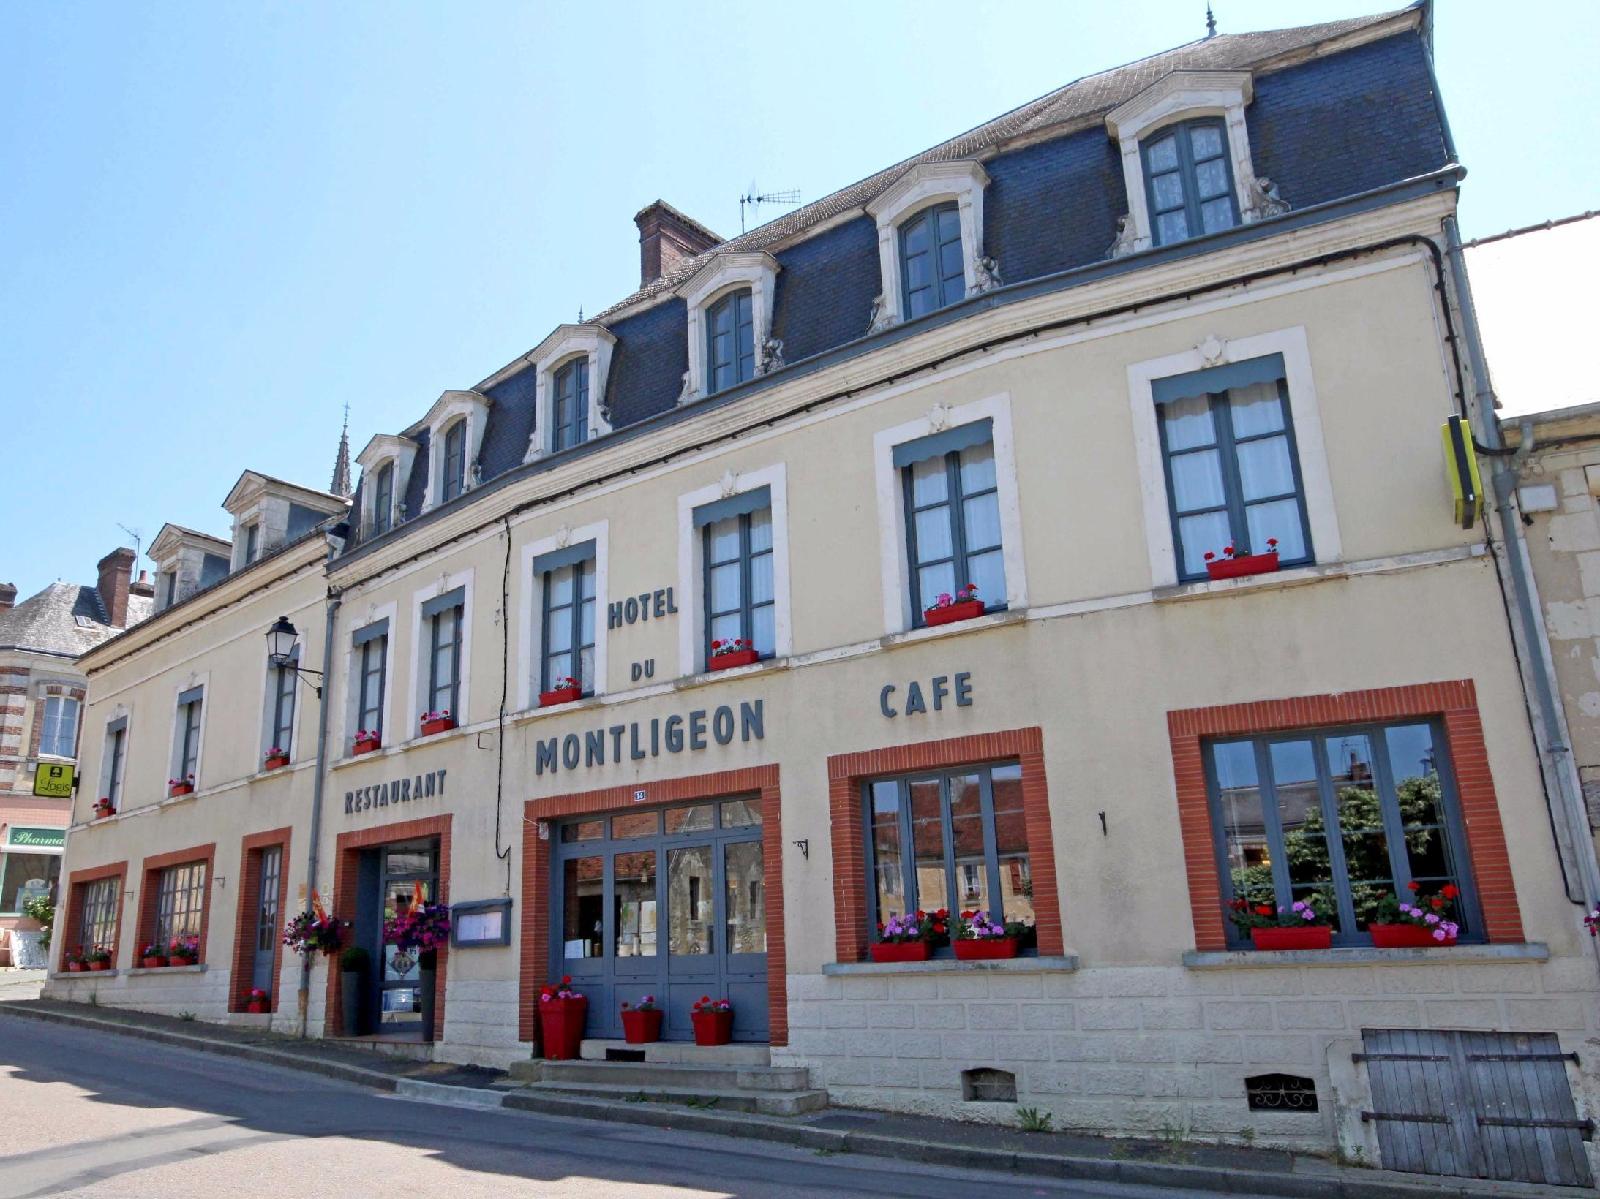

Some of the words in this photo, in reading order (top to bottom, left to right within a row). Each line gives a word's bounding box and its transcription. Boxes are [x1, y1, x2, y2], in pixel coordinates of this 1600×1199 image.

[608, 587, 678, 629] HOTEL
[631, 659, 655, 681] DU
[880, 671, 973, 718] CAFE
[536, 699, 764, 775] MONTLIGEON
[345, 769, 446, 814] RESTAURANT
